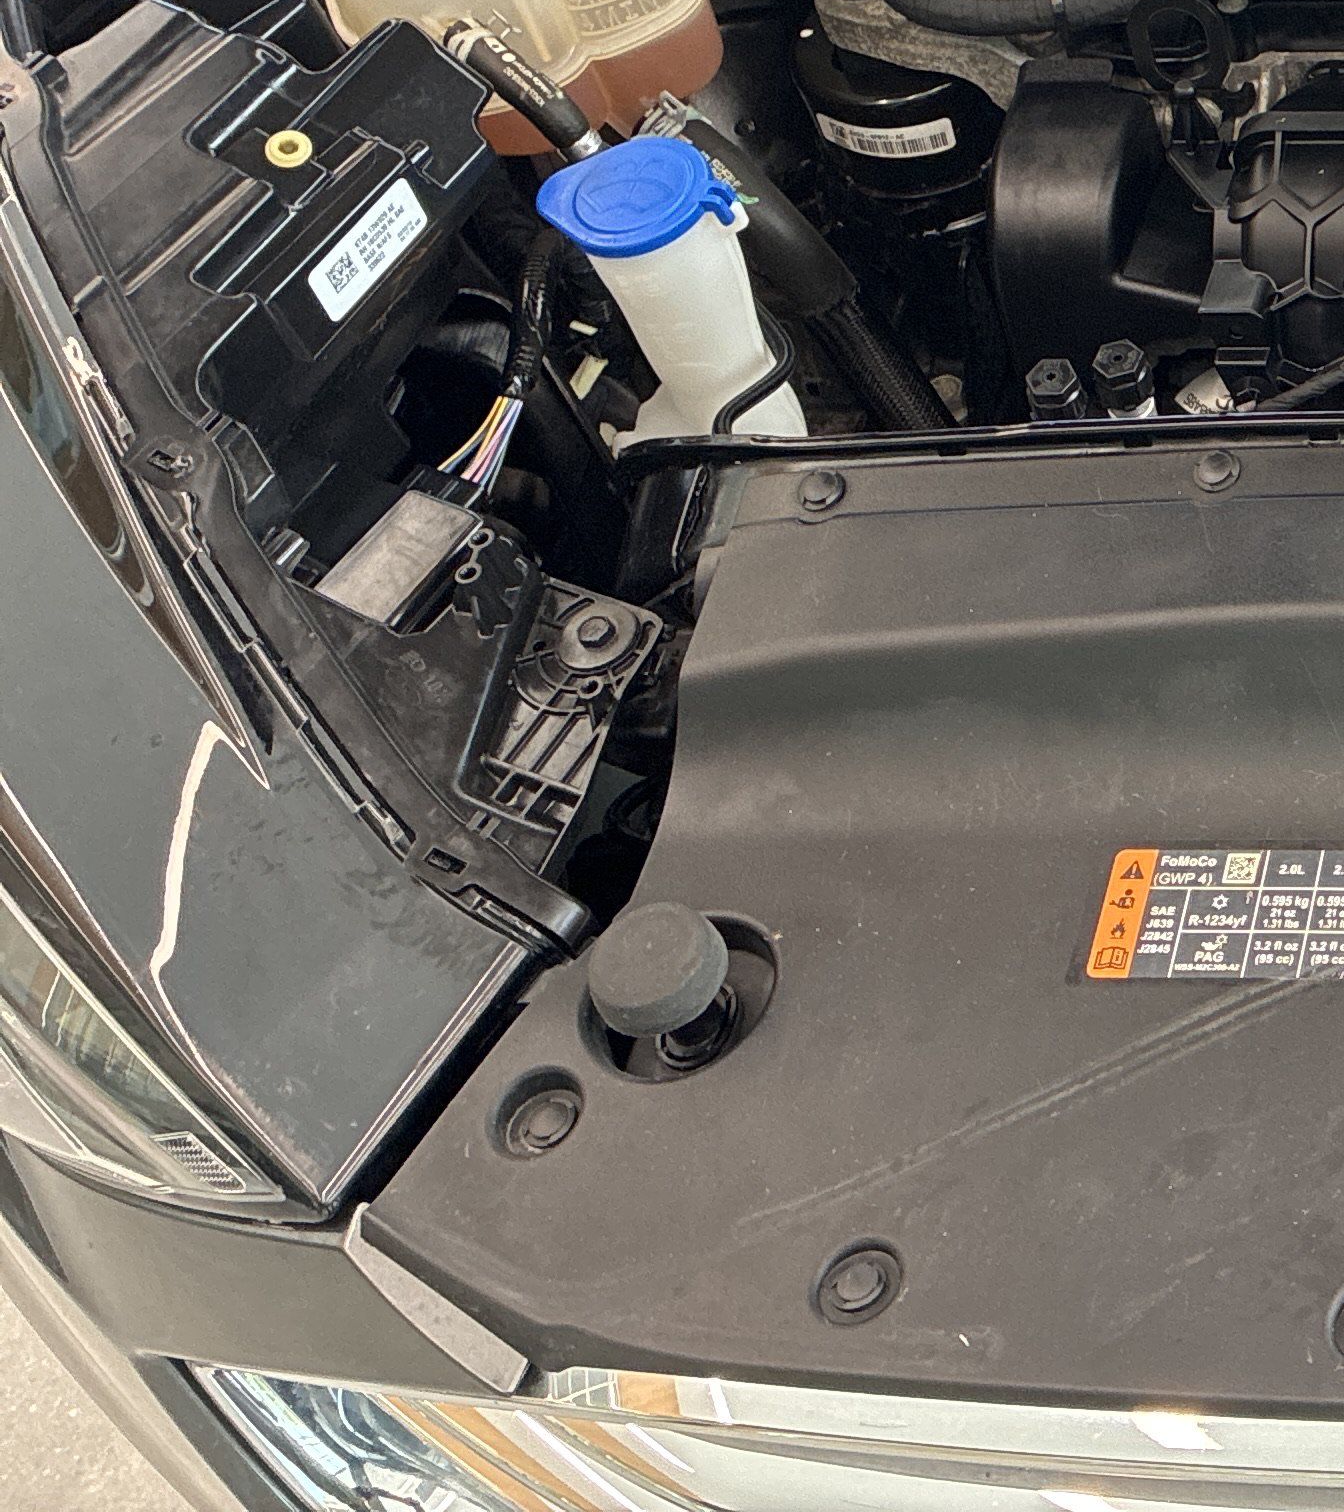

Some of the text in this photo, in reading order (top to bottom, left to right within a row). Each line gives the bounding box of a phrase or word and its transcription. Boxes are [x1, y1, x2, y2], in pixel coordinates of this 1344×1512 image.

[1160, 855, 1217, 867] FoMoCo
[1279, 864, 1305, 875] 2.0L
[1154, 872, 1213, 886] (GWP 4)
[1262, 895, 1310, 909] 0.595 kg
[1150, 906, 1176, 916] SAE
[1270, 908, 1297, 918] 21 oz
[1325, 908, 1337, 918] 21
[1145, 919, 1174, 928] J639
[1188, 914, 1248, 929] R-1234yf
[1263, 919, 1300, 929] 1.31 lbs
[1318, 919, 1338, 929] 1.31
[1253, 941, 1299, 951] 3.2 fl oz
[1309, 941, 1328, 951] 3.2
[1329, 941, 1338, 951] fl
[1194, 950, 1224, 963] PAG
[1254, 953, 1294, 966] (95 cc)
[1311, 954, 1329, 966] (95
